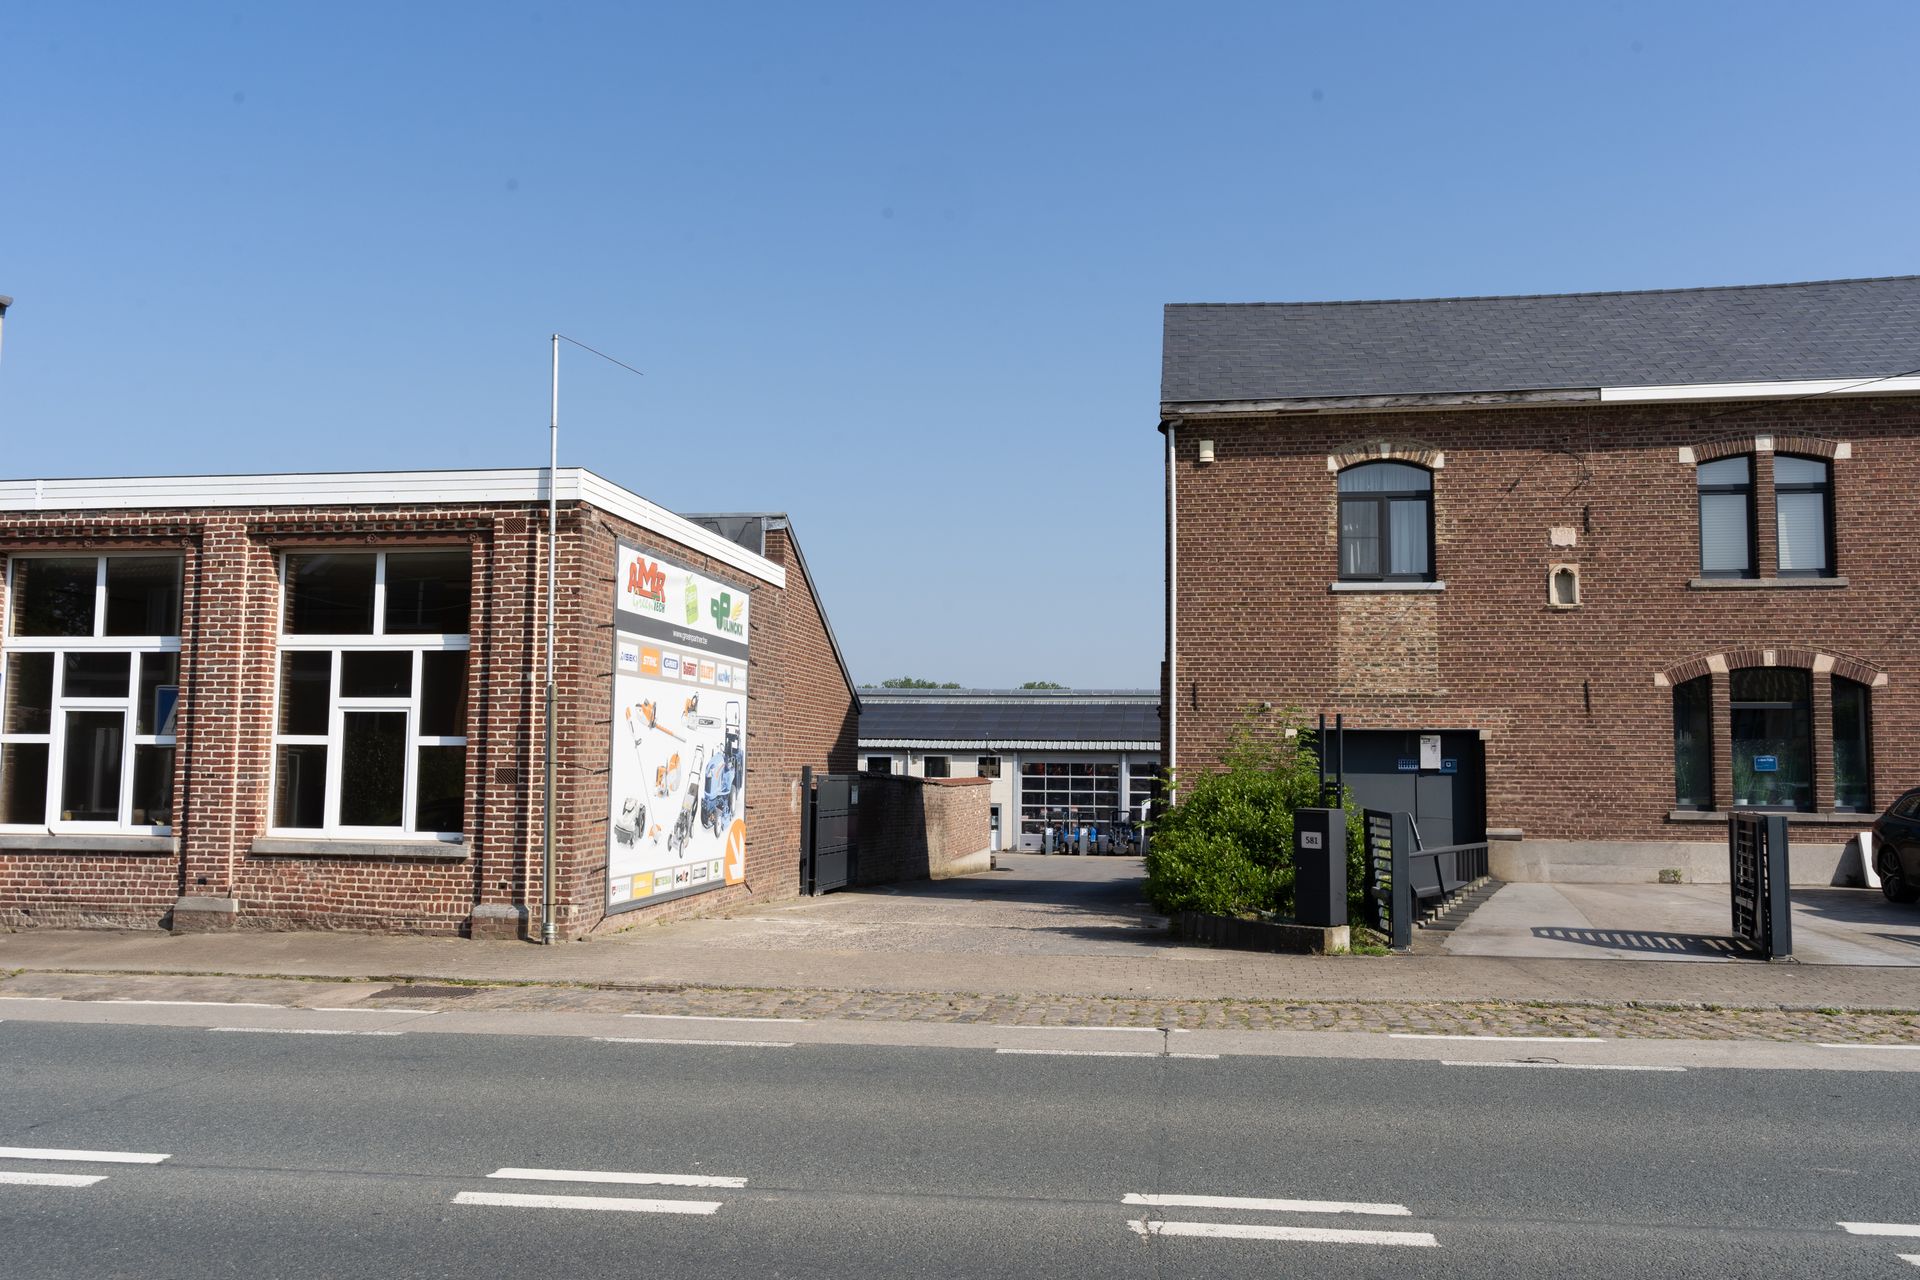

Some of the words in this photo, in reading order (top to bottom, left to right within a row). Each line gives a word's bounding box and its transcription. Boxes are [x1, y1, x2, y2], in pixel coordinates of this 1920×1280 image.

[628, 557, 666, 603] AMR
[642, 655, 658, 667] STIHL
[1305, 836, 1318, 844] 581
